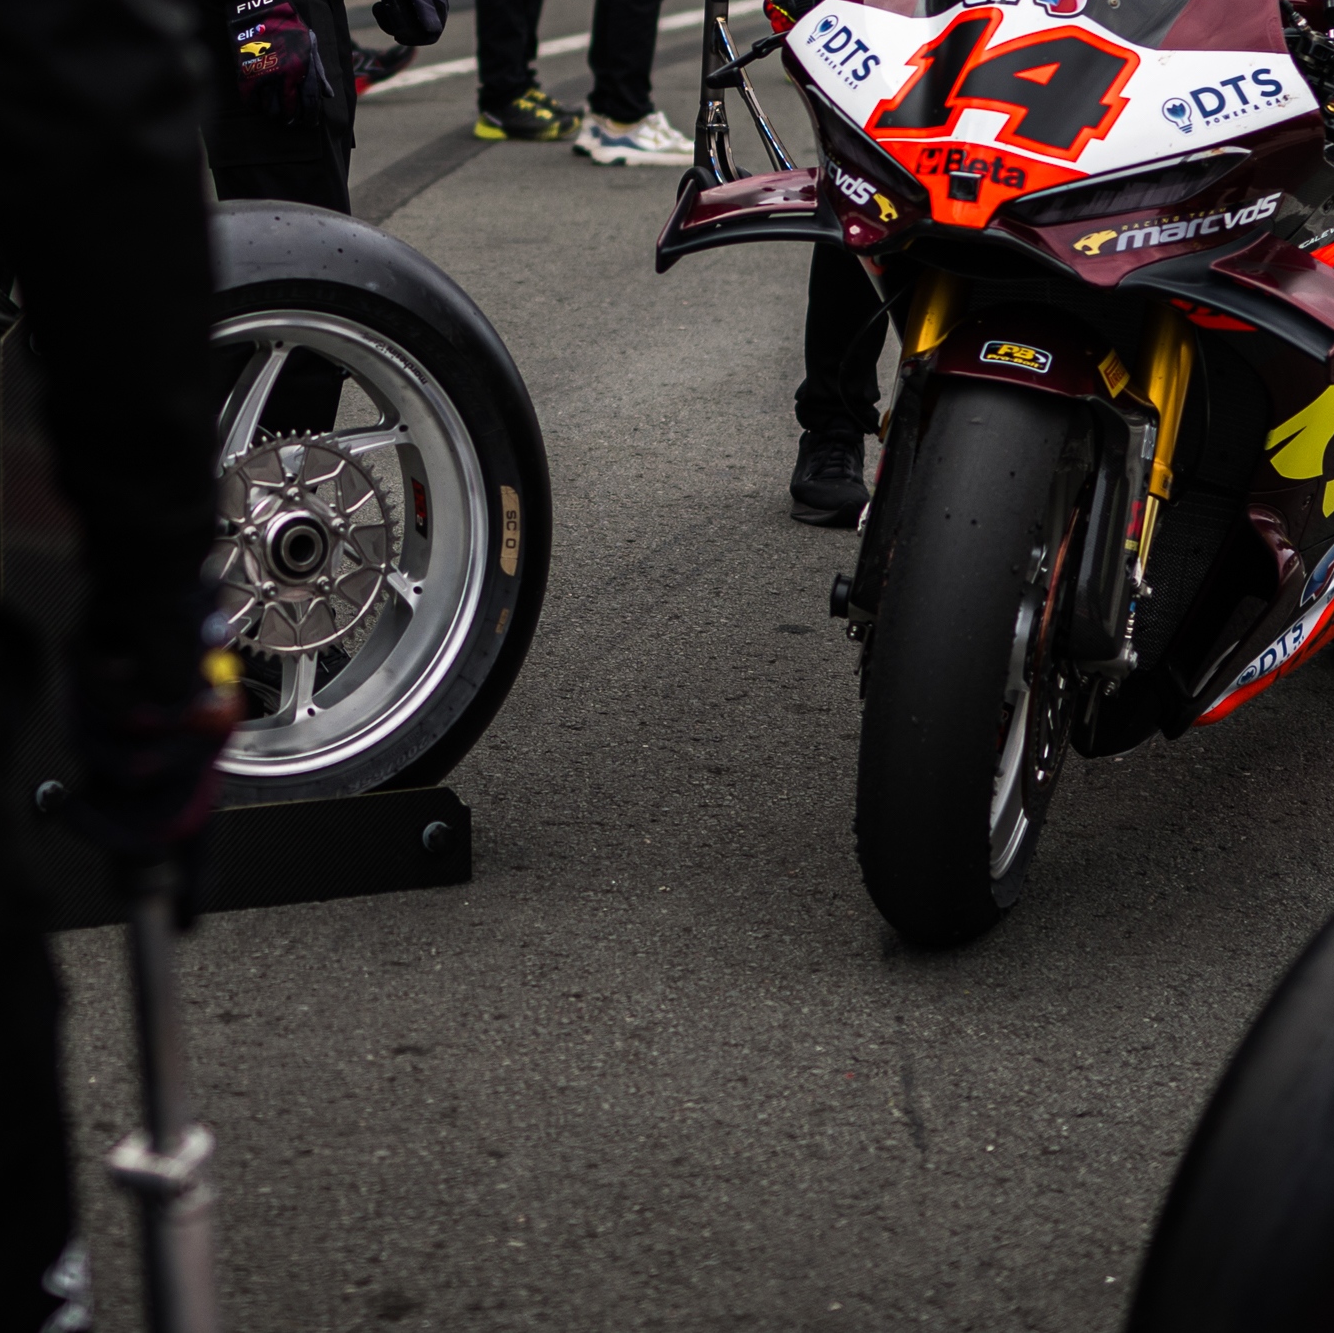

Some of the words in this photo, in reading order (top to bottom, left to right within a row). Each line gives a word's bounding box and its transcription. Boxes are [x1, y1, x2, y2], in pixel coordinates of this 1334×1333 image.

[237, 27, 255, 41] elf
[822, 26, 881, 82] DTS
[869, 7, 1140, 162] 14
[1189, 68, 1283, 119] DTS
[1205, 108, 1248, 127] POWER
[1266, 94, 1291, 107] GAS
[943, 148, 1027, 191] Beta
[1122, 216, 1180, 231] RACING
[1190, 207, 1227, 219] TEAM
[997, 343, 1037, 360] PB
[1259, 620, 1304, 676] DTS
